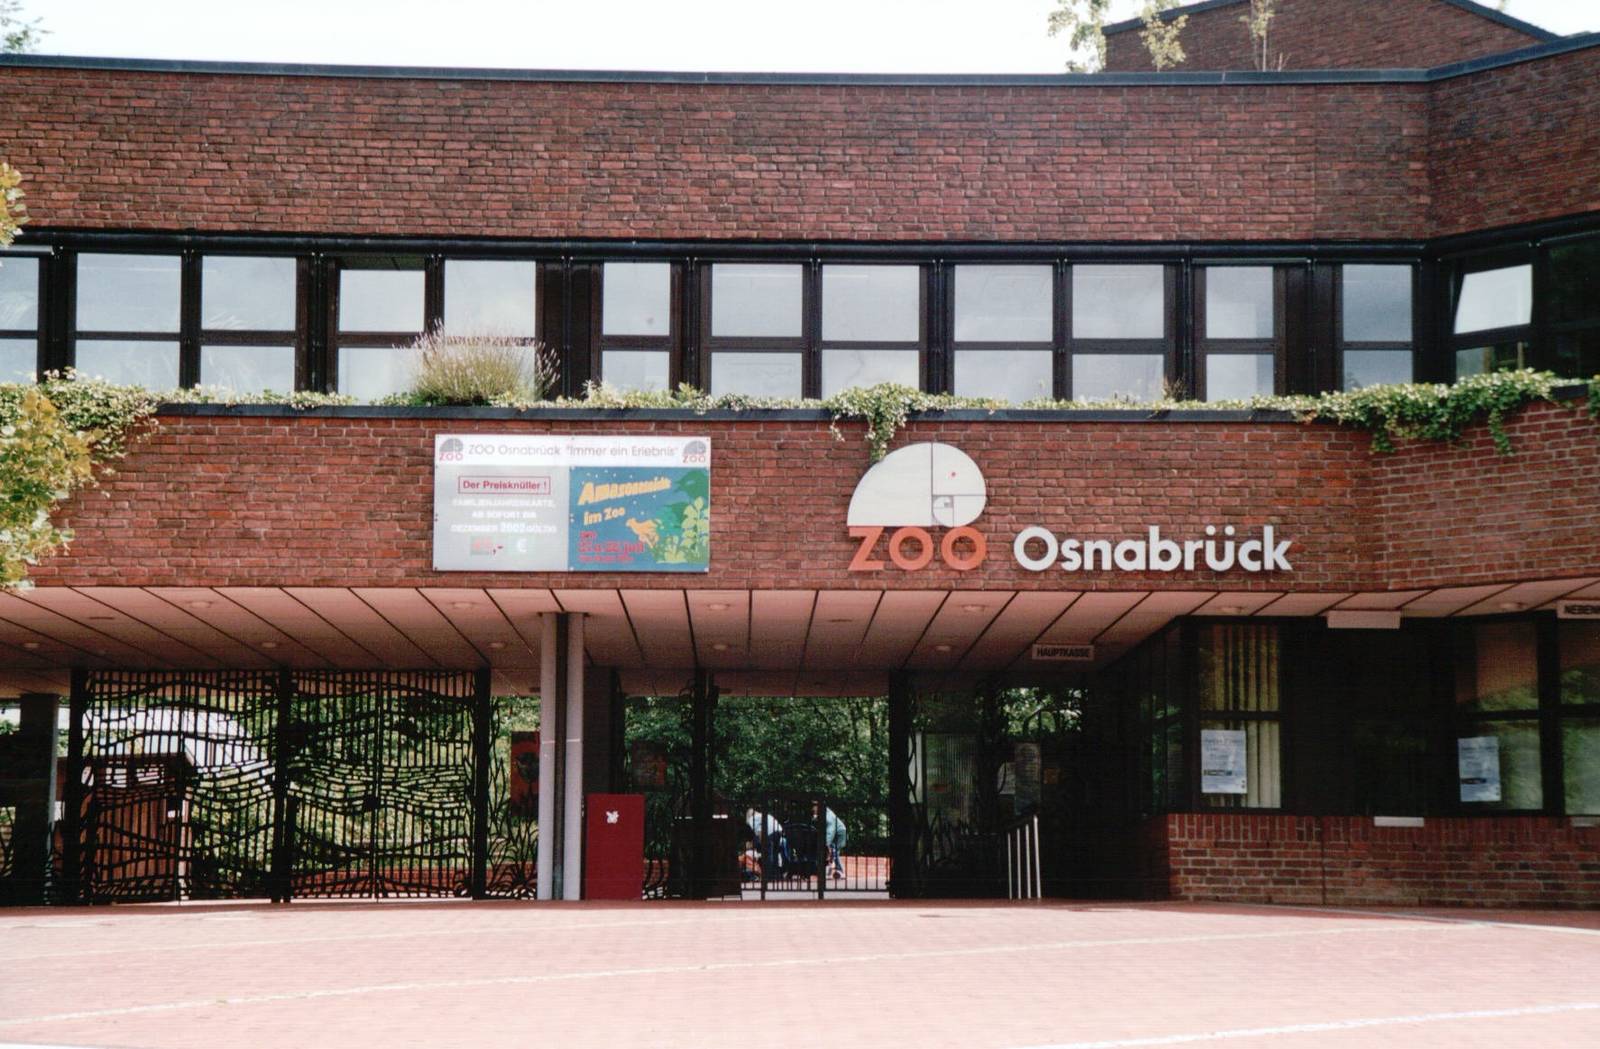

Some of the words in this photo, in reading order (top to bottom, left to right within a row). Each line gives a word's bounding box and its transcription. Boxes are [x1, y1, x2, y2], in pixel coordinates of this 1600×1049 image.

[468, 444, 495, 455] ZOO
[498, 444, 561, 456] Osnabrück
[610, 446, 628, 456] ein
[439, 452, 464, 461] ZOO
[682, 454, 706, 464] ZOO
[463, 480, 480, 489] Der
[483, 480, 541, 490] Preisknüller
[847, 526, 988, 572] ZOO
[1013, 524, 1293, 572] Osnabrück
[1036, 647, 1090, 658] HAUPTKASSE
